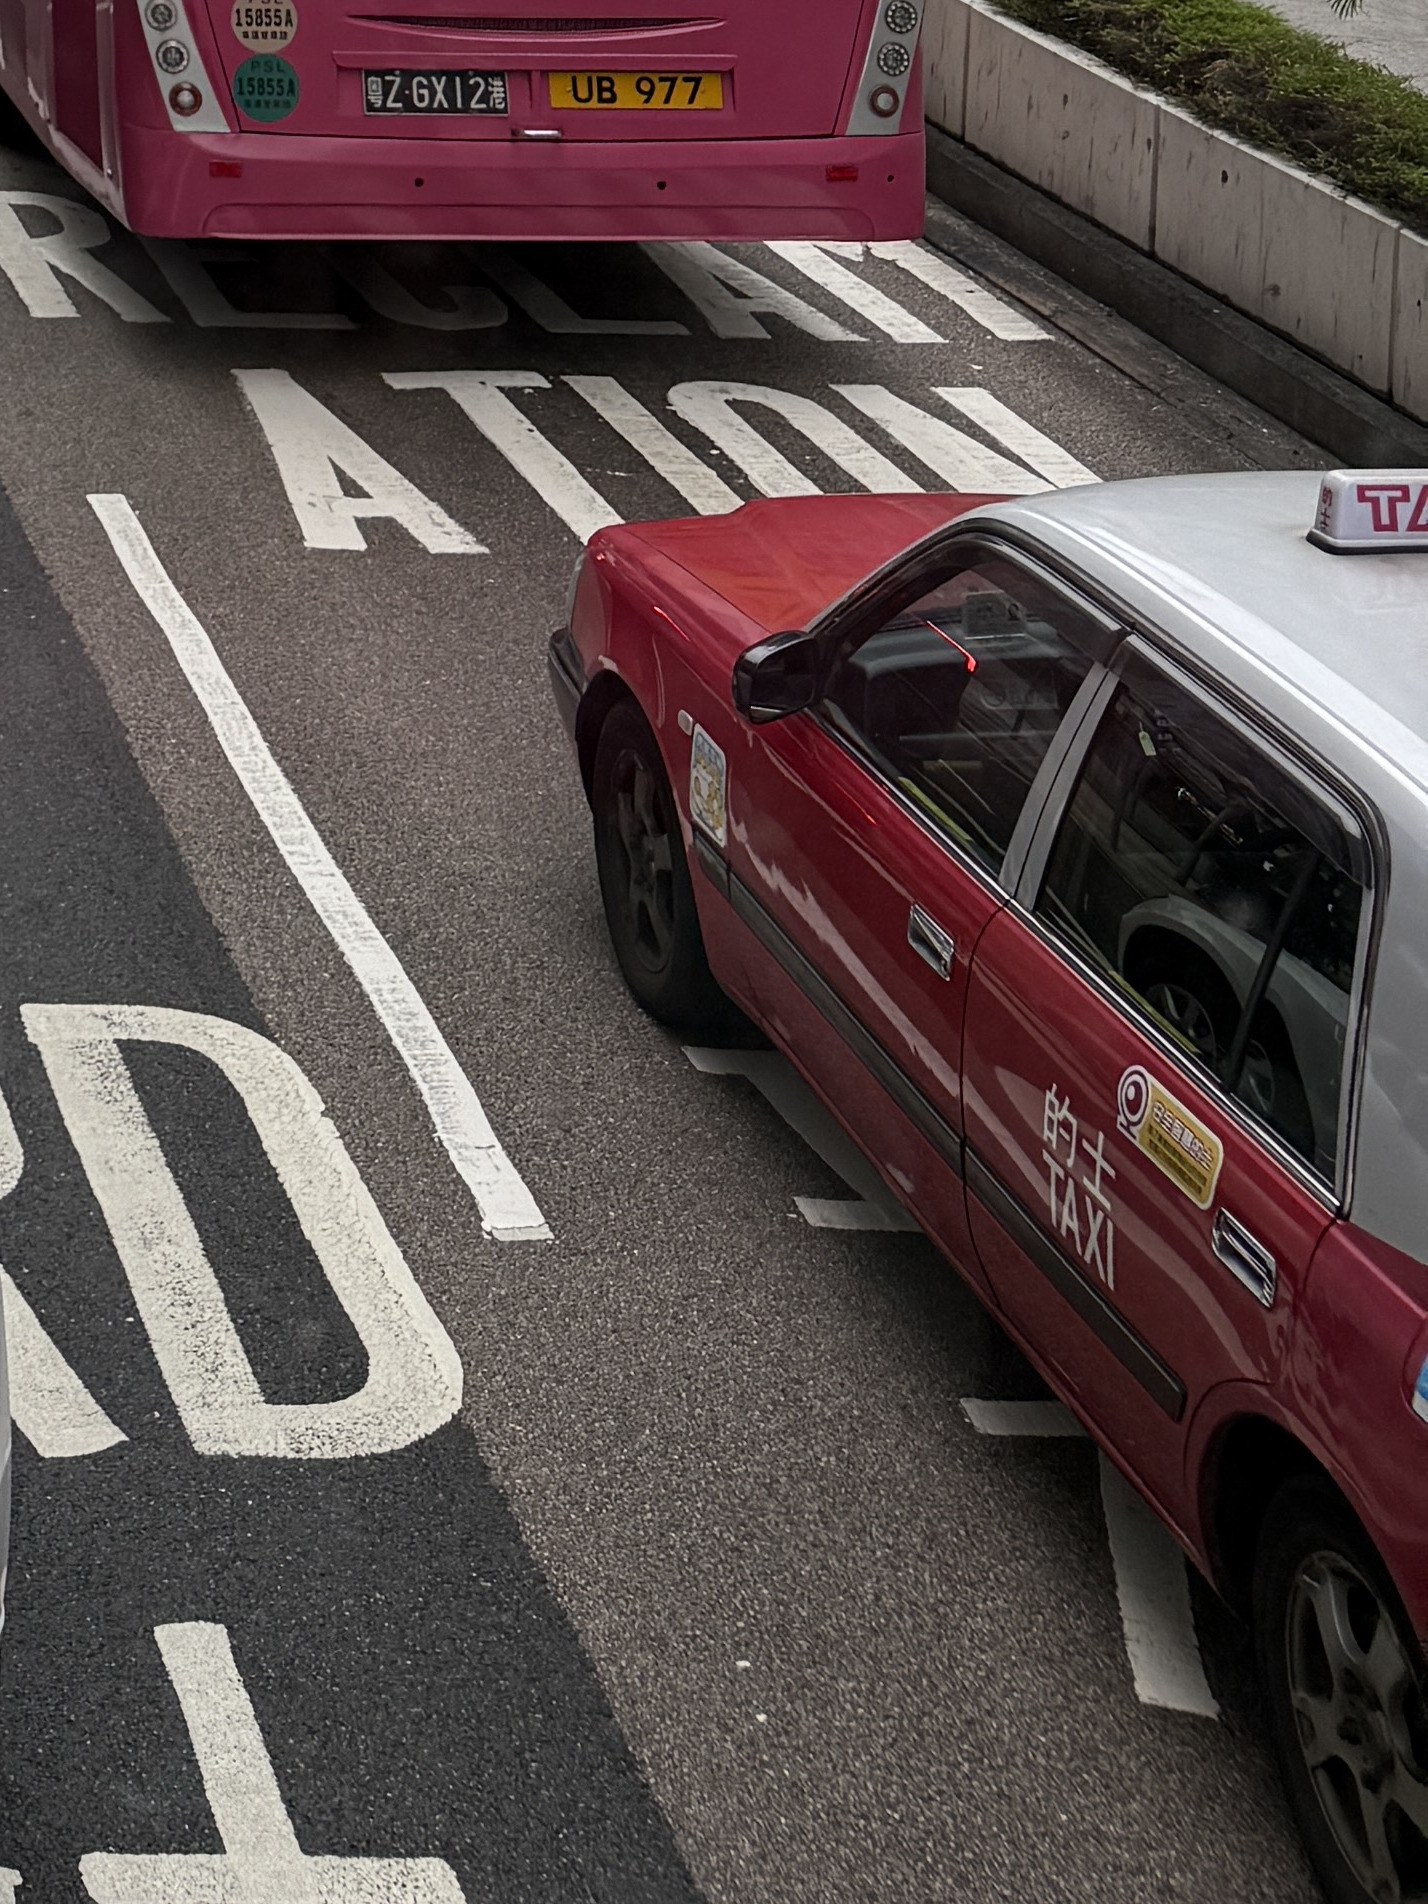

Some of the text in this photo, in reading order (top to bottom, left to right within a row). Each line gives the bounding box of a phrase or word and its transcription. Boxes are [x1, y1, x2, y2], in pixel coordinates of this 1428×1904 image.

[235, 8, 293, 27] 15855A
[251, 61, 286, 73] PSL
[237, 78, 296, 96] 15855A
[571, 76, 702, 105] UB 977
[1044, 1083, 1116, 1212] 的士
[1042, 1149, 1115, 1291] TAXI
